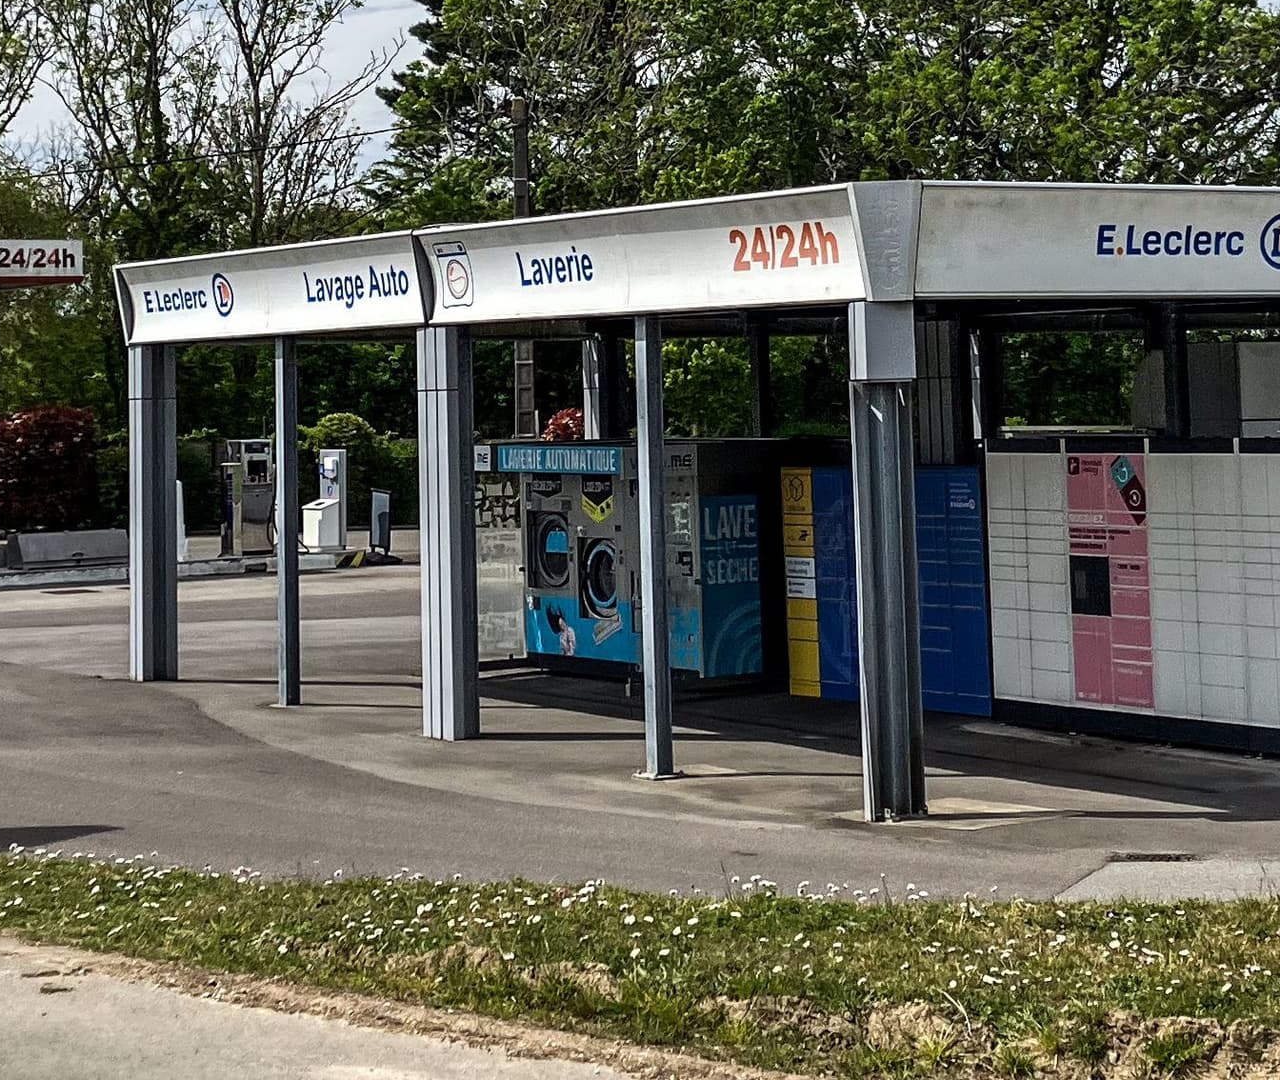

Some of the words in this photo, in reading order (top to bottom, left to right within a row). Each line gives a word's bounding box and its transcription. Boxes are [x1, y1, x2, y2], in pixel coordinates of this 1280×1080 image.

[729, 221, 840, 271] 24/24h
[1096, 224, 1245, 256] E.Leclerc
[515, 245, 594, 287] Laverie
[143, 287, 208, 314] E.Leclerc
[302, 270, 365, 309] Lavage
[369, 263, 410, 299] Auto
[545, 448, 617, 472] AUTOMATIQUE
[704, 504, 758, 541] LAVE
